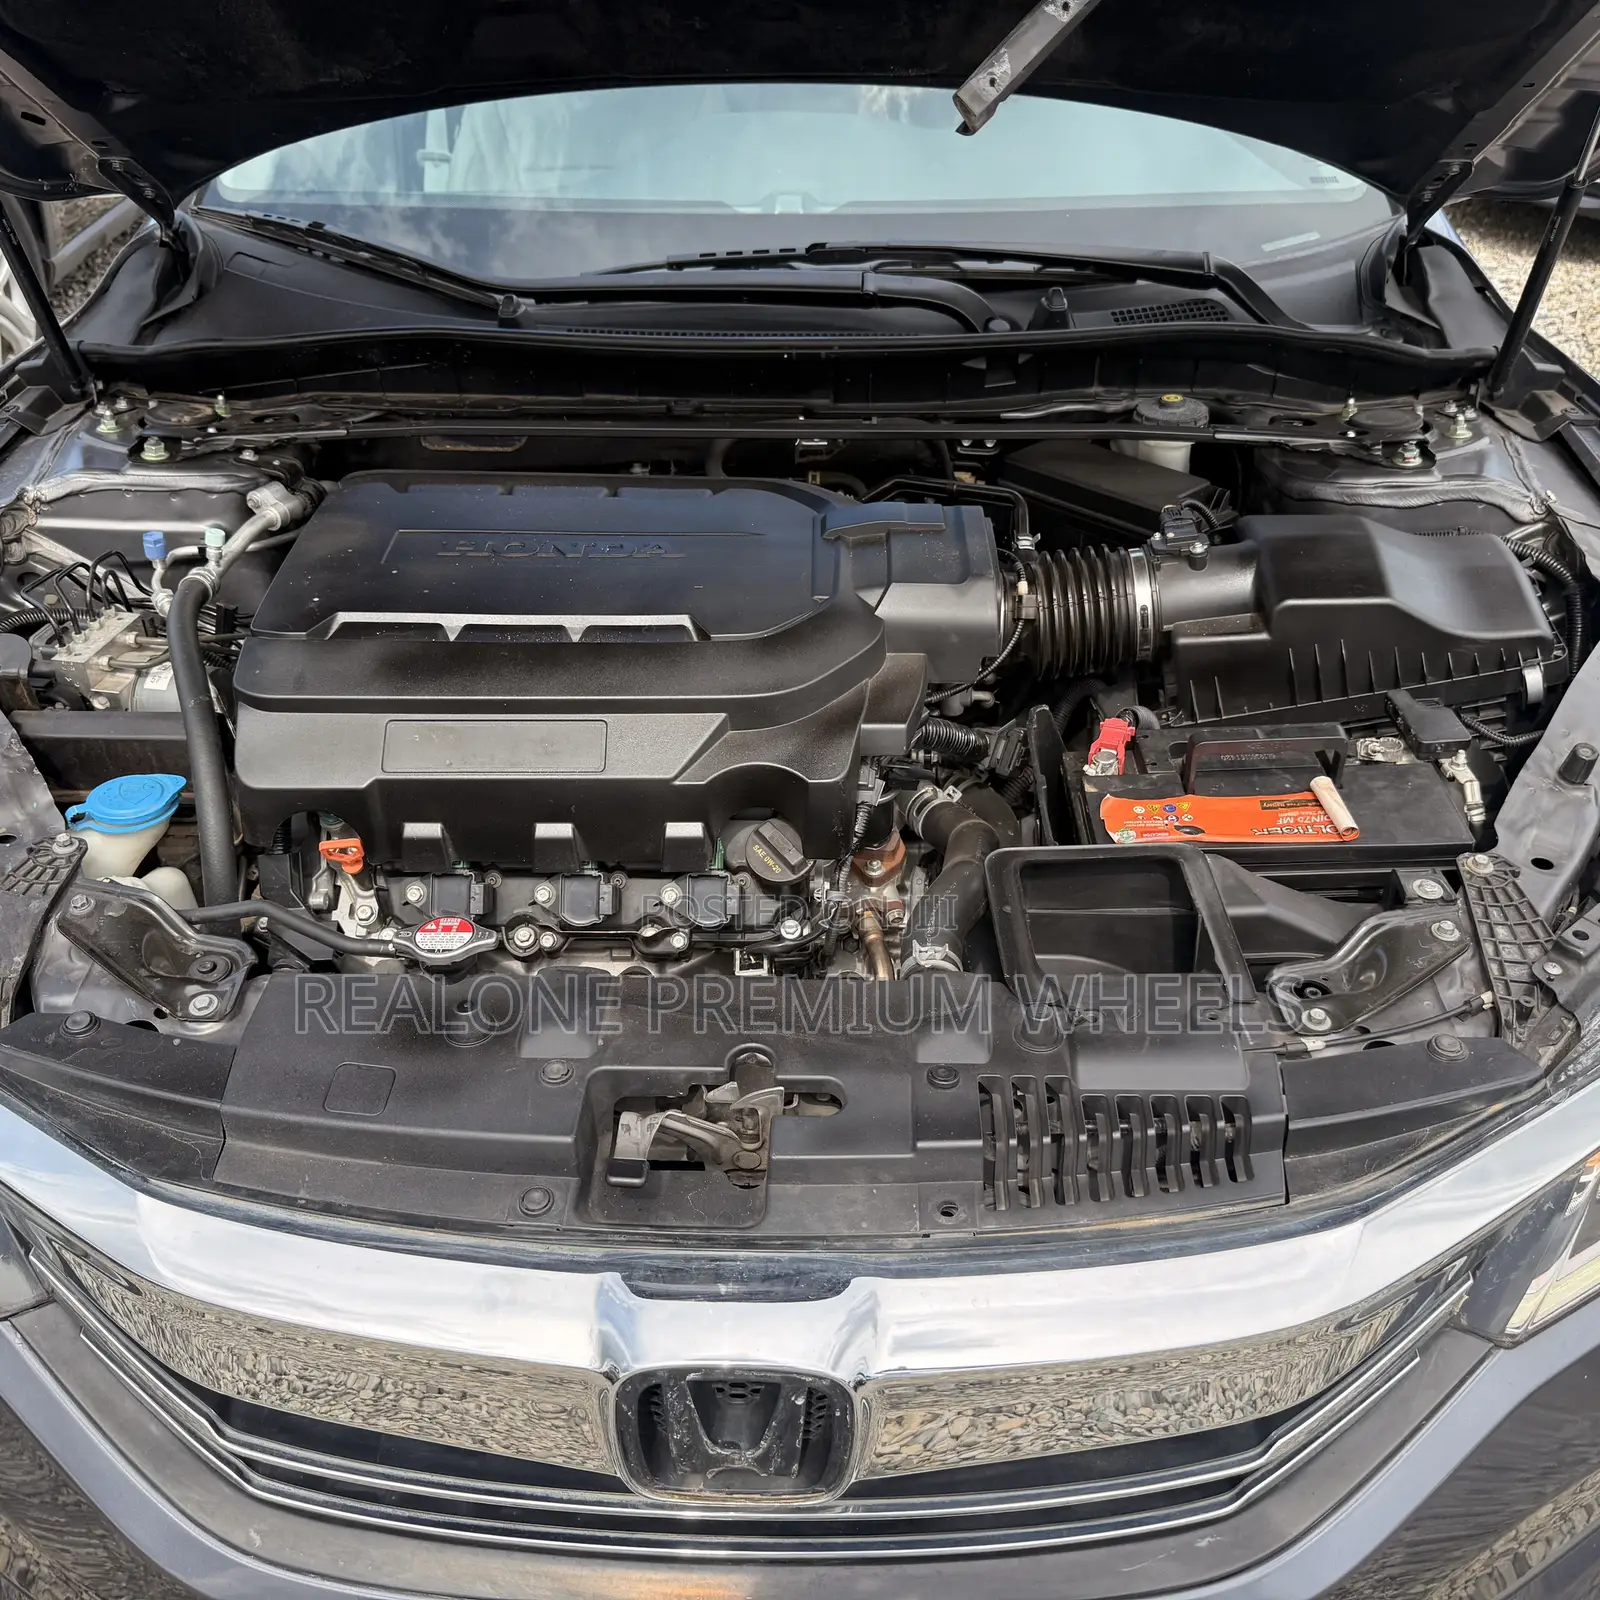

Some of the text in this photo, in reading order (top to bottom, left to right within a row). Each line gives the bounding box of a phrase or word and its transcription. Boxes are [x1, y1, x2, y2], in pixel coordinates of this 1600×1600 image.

[437, 540, 686, 558] HONDA
[752, 844, 782, 874] SAE 0W-20
